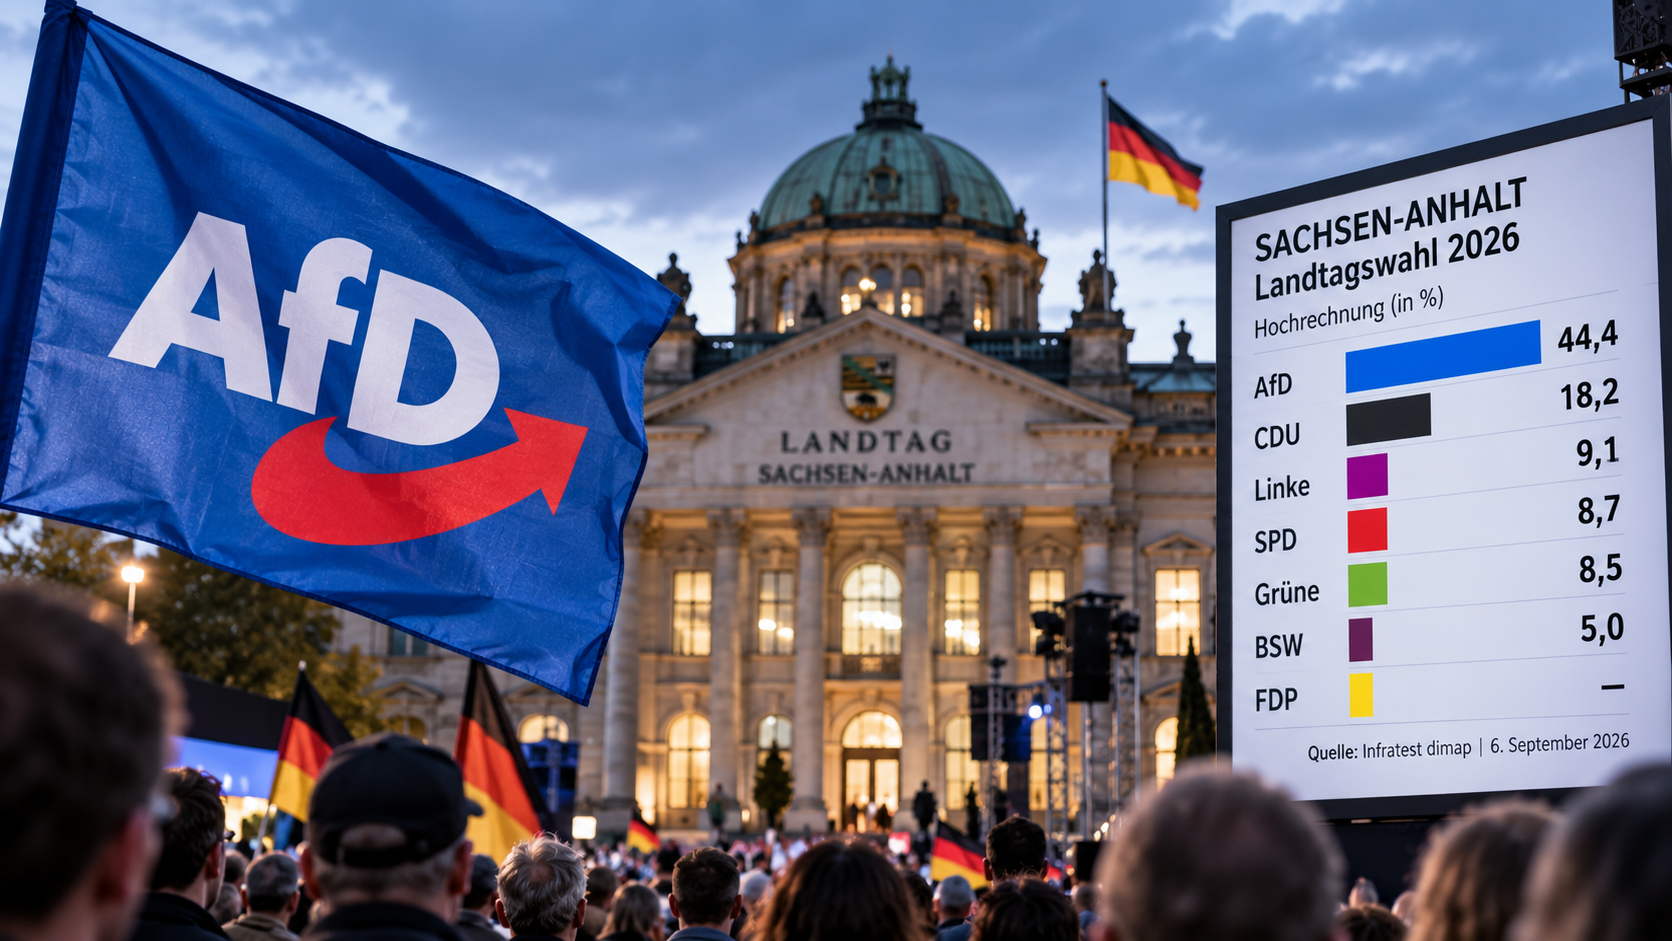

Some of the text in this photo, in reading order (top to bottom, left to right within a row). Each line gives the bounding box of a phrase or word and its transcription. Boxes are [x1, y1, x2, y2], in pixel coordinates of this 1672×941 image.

[1255, 176, 1528, 262] SACHSEN-ANHALT
[1255, 221, 1520, 301] Landtagswahl 2026
[107, 211, 499, 446] AfD
[1254, 285, 1445, 339] Hochrechnung (in %)
[1557, 318, 1619, 355] 44,4
[1253, 372, 1293, 400] AfD
[1560, 377, 1620, 413] 18,2
[780, 428, 953, 454] LANDTAG
[1254, 422, 1300, 450] CDU
[1576, 435, 1620, 471] 9,1
[757, 461, 976, 485] SACHSEN-ANHALT
[1255, 474, 1310, 502] Linke
[1577, 493, 1621, 529] 8,7
[1254, 527, 1297, 554] SPD
[1579, 552, 1623, 588] 8,5
[1254, 580, 1320, 606] Grüne
[1255, 632, 1304, 659] BSW
[1580, 612, 1625, 647] 5,0
[1255, 687, 1298, 712] FDP
[1307, 743, 1358, 763] Quelle:
[1363, 741, 1423, 759] Infratest
[1426, 739, 1472, 759] dimap
[1490, 737, 1504, 754] 6.
[1508, 733, 1589, 756] September
[1593, 732, 1630, 750] 2026
